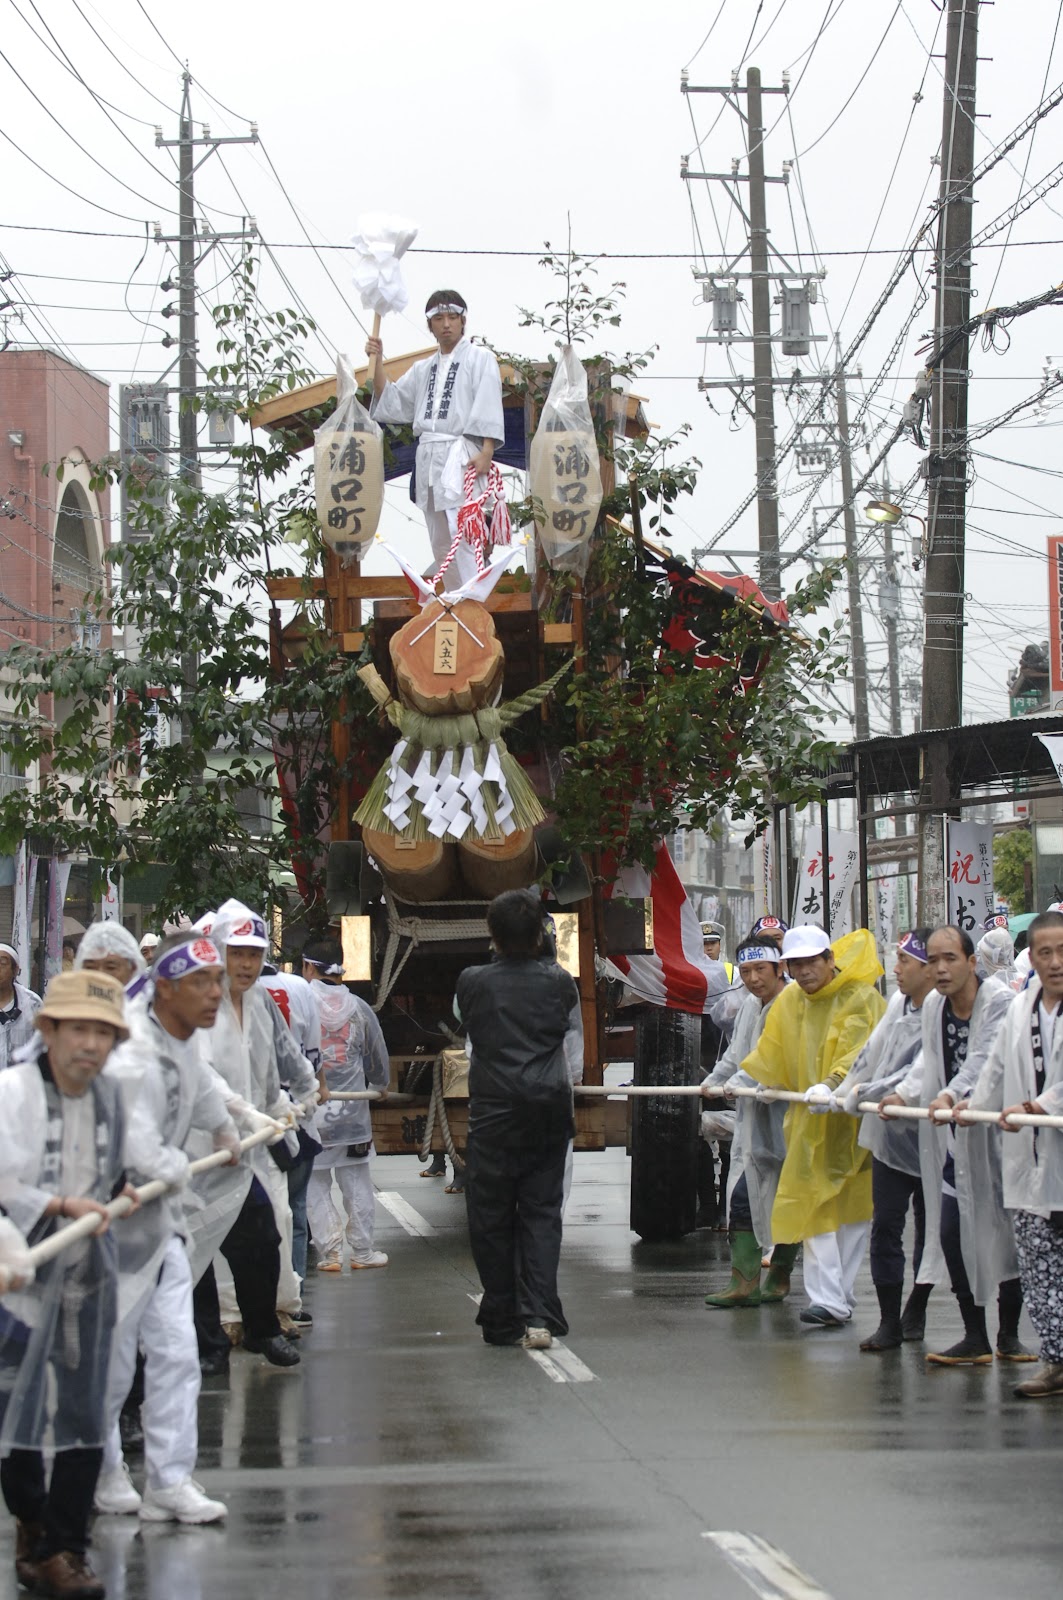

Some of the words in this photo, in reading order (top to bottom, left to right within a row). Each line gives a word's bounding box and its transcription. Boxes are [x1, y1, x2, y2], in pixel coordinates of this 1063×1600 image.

[327, 436, 367, 535] 浦口町
[552, 442, 591, 537] 浦口町
[439, 629, 454, 669] 一八五六
